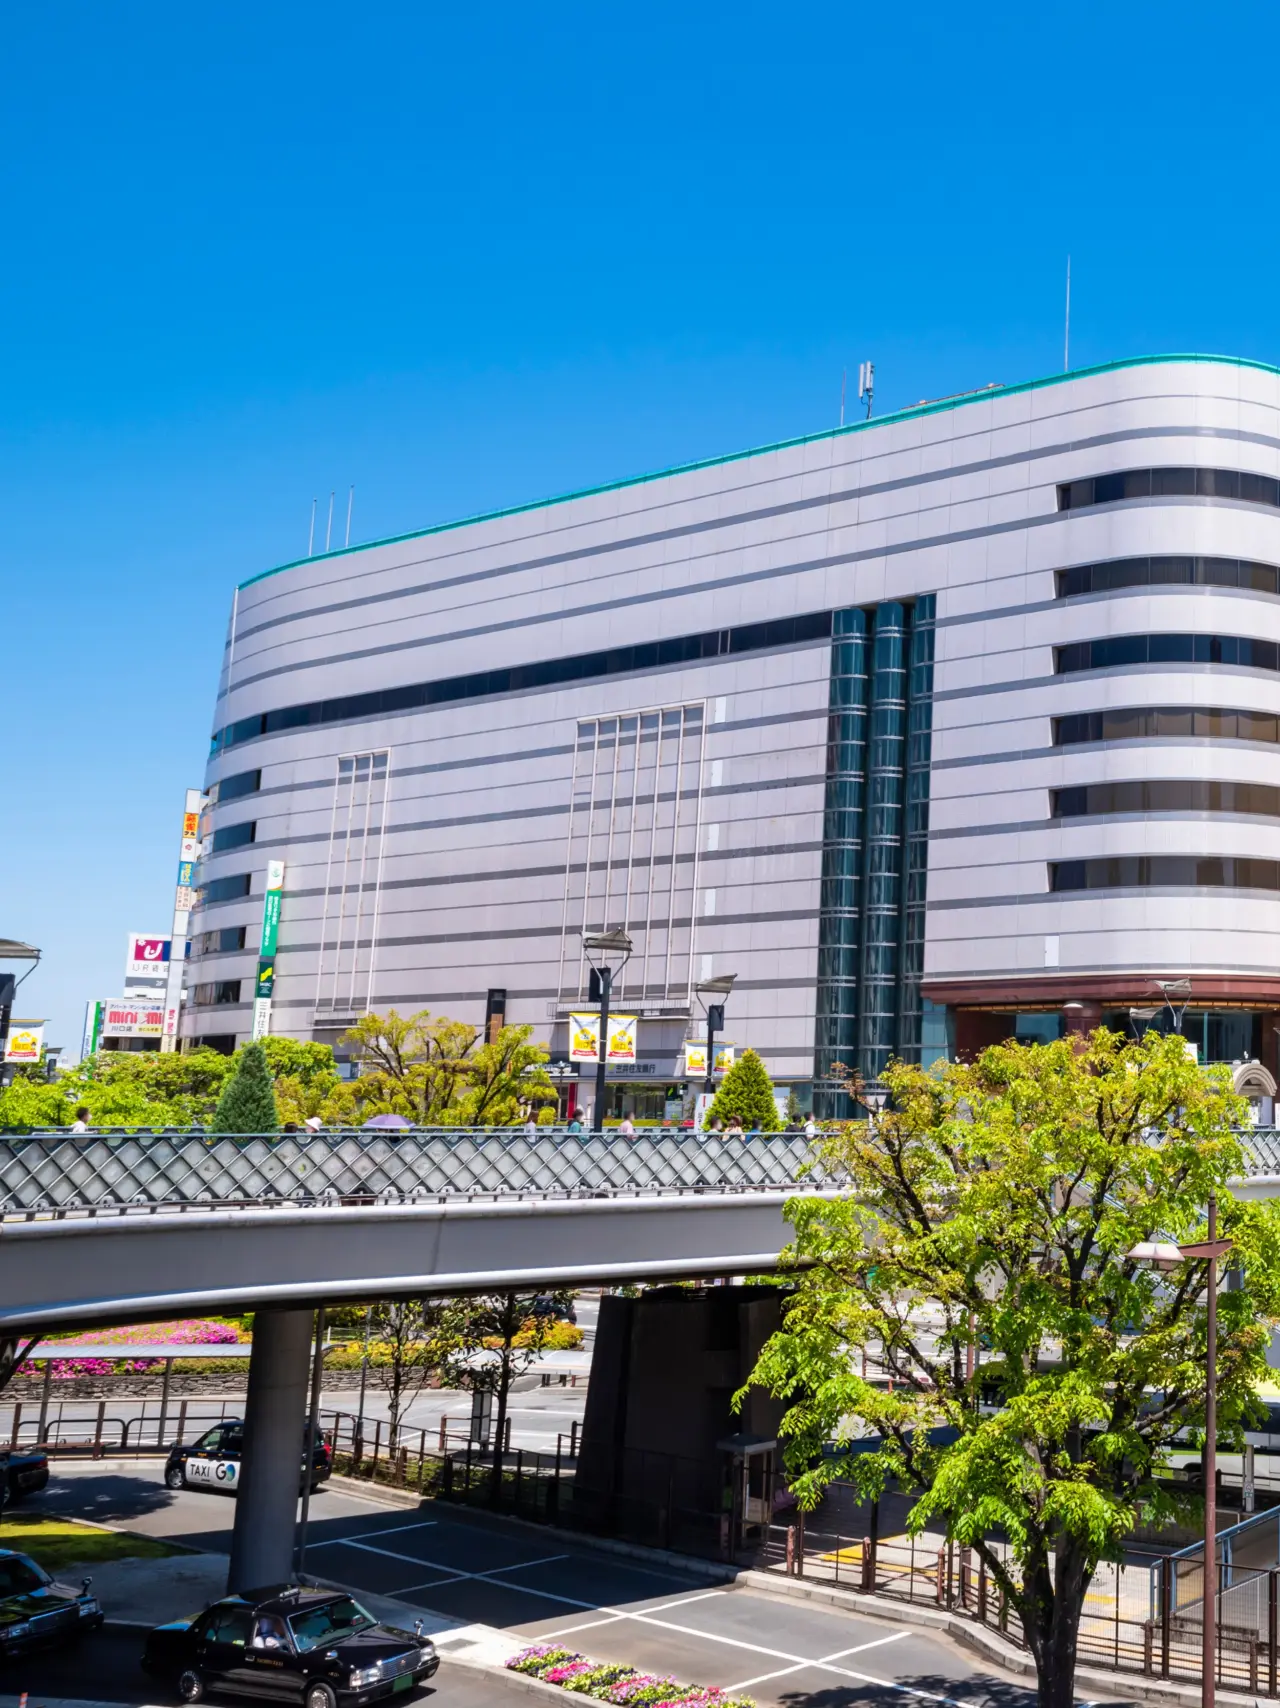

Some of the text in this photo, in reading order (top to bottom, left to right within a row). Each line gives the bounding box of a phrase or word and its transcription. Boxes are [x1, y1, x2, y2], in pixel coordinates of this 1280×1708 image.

[108, 1011, 138, 1024] mini
[190, 1462, 236, 1482] TAXI GO
